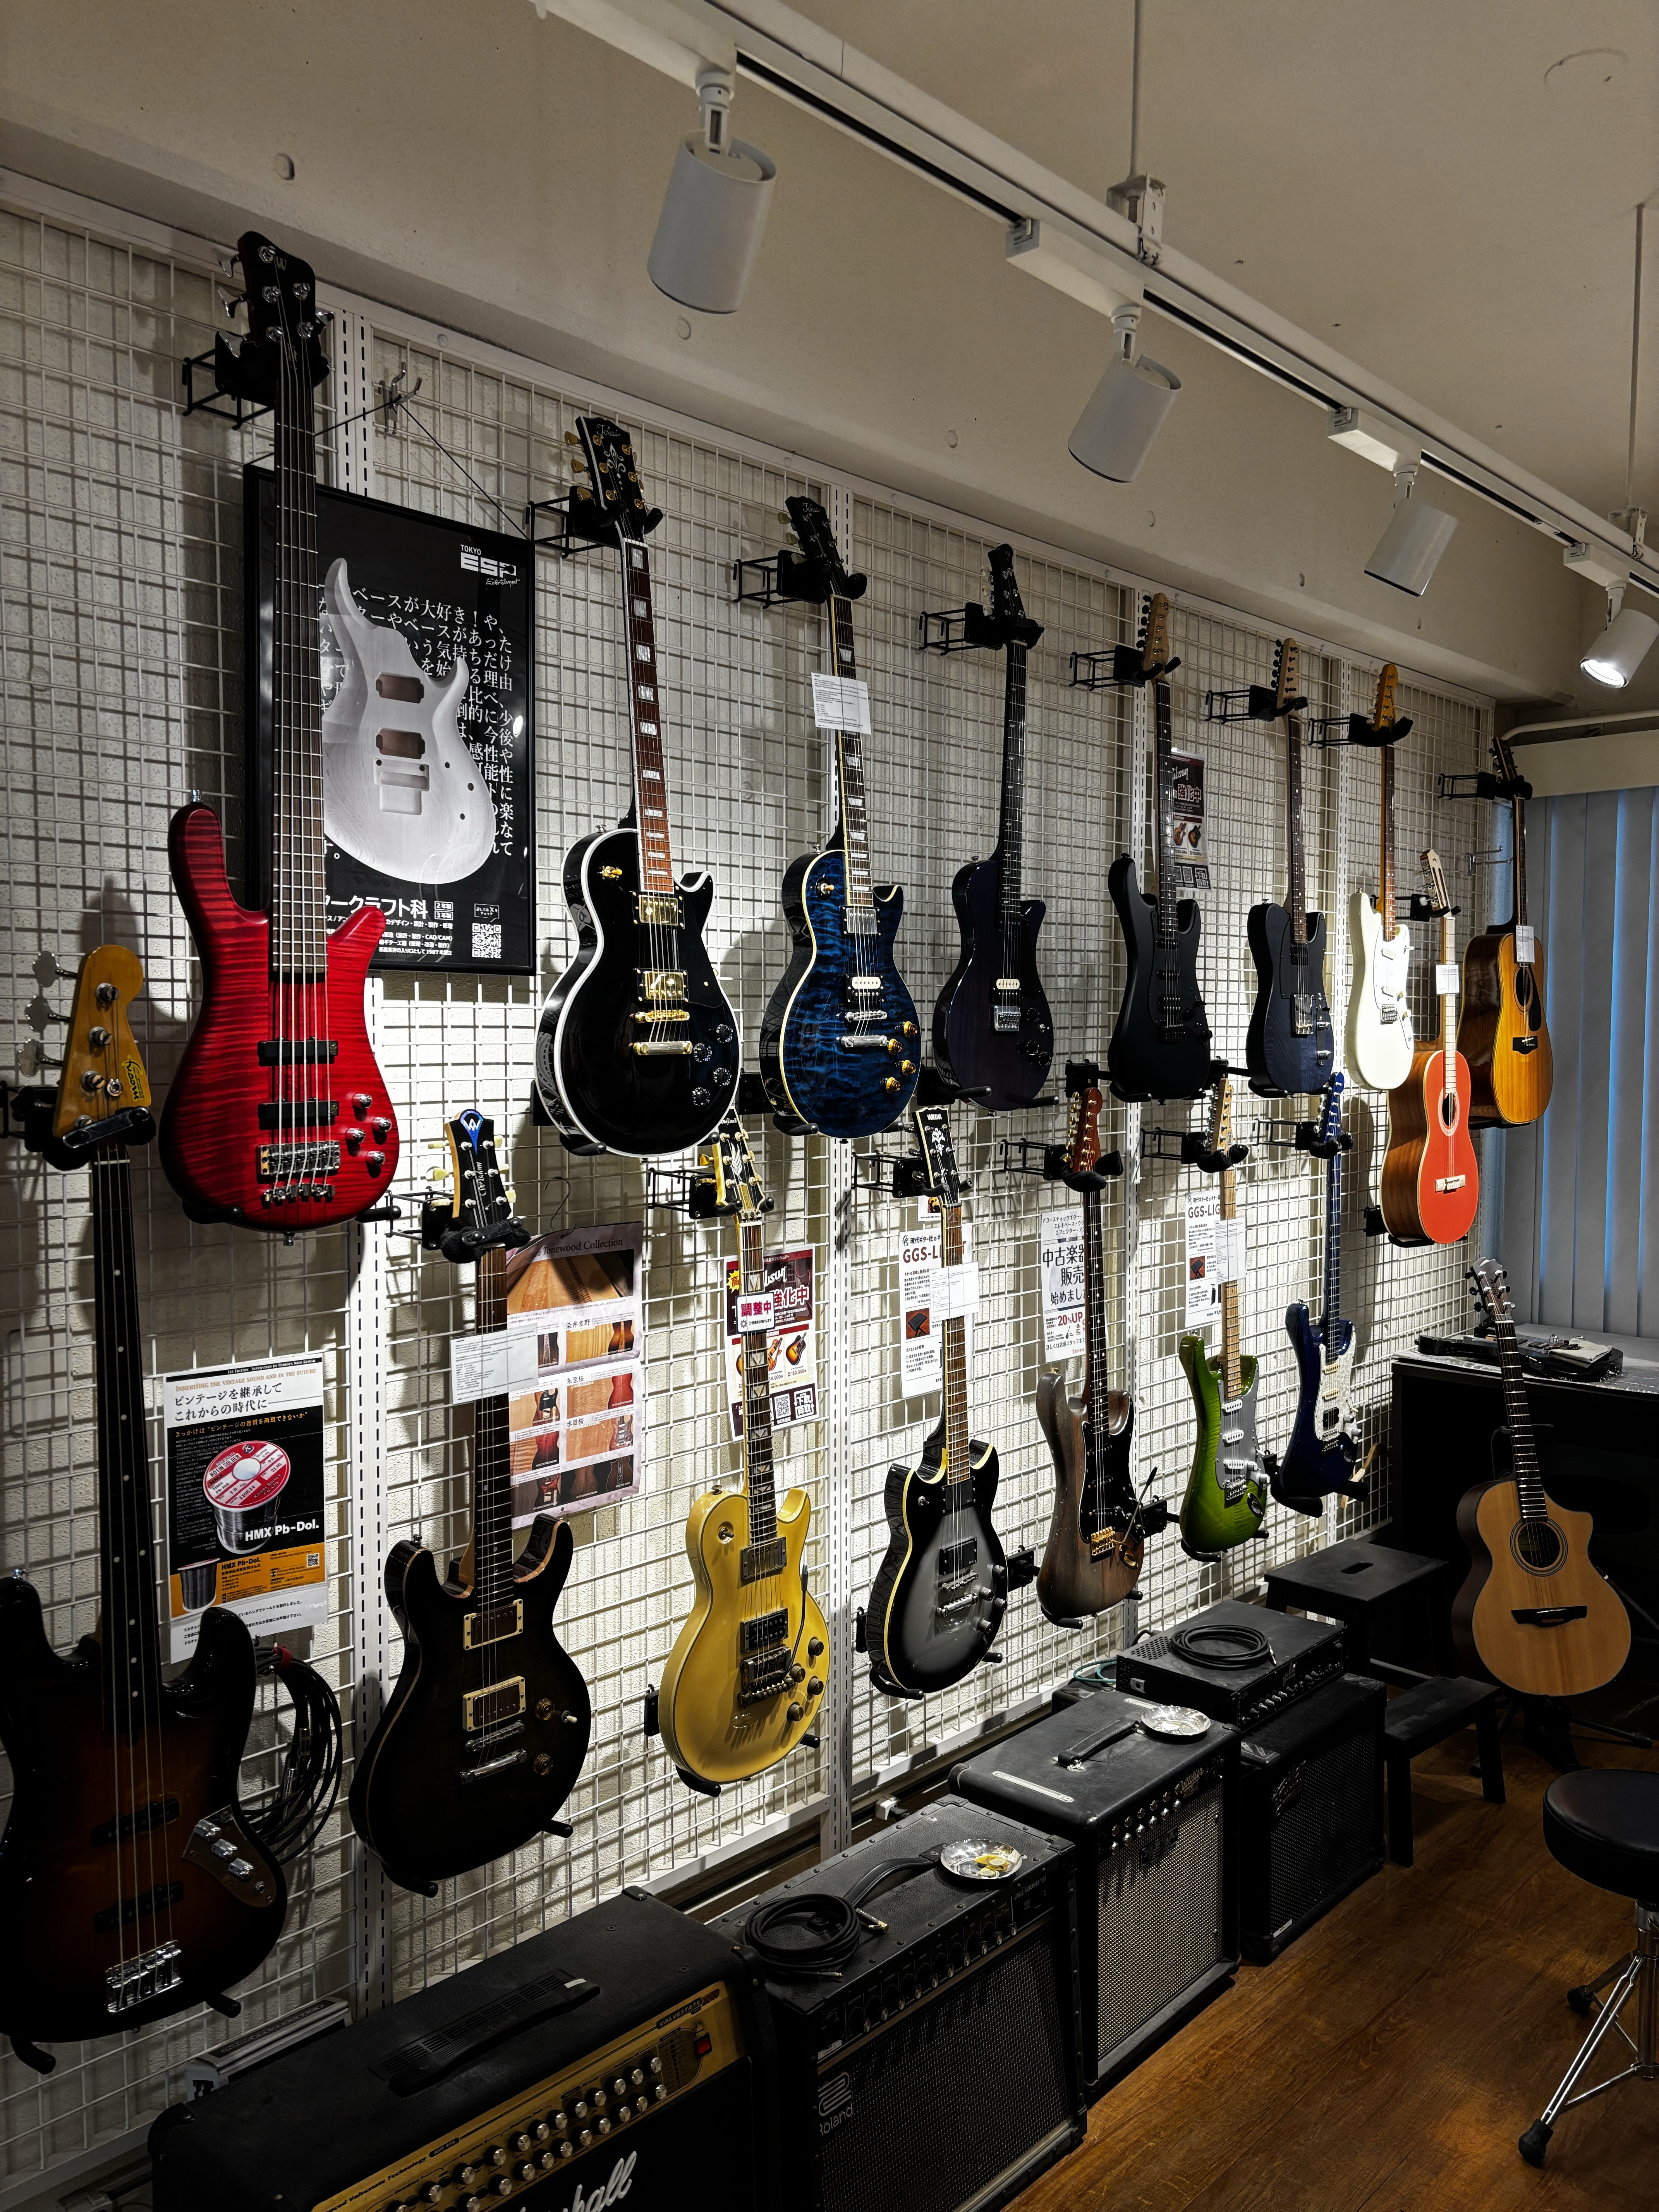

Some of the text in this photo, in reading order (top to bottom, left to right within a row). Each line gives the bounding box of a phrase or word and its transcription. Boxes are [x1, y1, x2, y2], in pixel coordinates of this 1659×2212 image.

[460, 544, 481, 555] TOKYO
[460, 552, 517, 578] ESP
[486, 578, 520, 587] Entertainment
[543, 1242, 581, 1255] Tonewood
[583, 1239, 623, 1250] Collection
[1061, 1265, 1084, 1287] 販売
[1051, 1288, 1085, 1306] 始めまし
[741, 1300, 772, 1317] 調整中
[1058, 1311, 1083, 1326] 20%UP
[566, 1319, 591, 1329] 染井吉野
[175, 1382, 282, 1406] ビンテージを継承して
[175, 1400, 267, 1422] これからの時代に
[210, 1454, 241, 1477] KOTIN SOLDER
[245, 1519, 319, 1541] HMX Pb-Dol.
[222, 1557, 261, 1570] HMX Pb-Dol.
[1144, 1831, 1176, 1858] MESA
[659, 2000, 701, 2028] VALVESTATE
[819, 2101, 853, 2136] Roland
[349, 2179, 385, 2202] Valvestate
[387, 2157, 426, 2180] Technology
